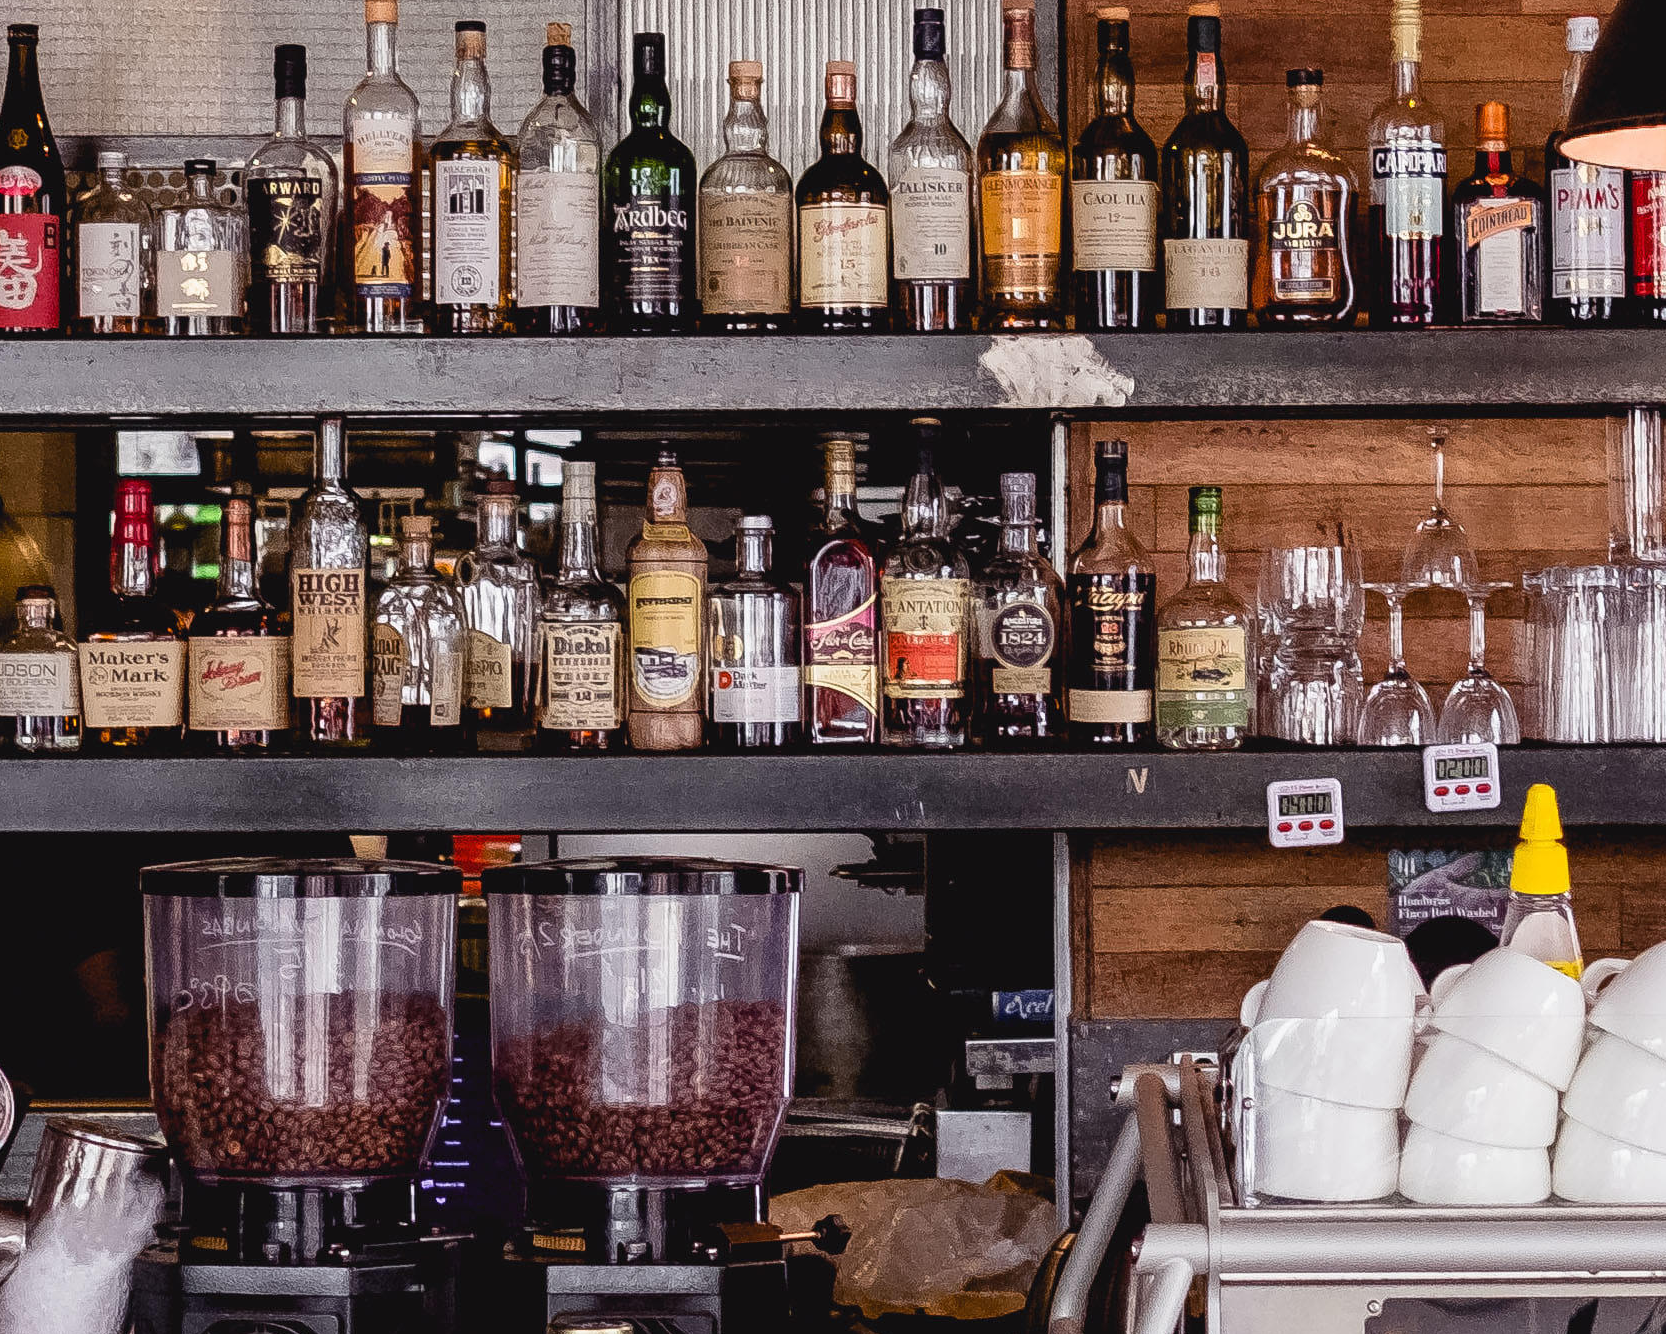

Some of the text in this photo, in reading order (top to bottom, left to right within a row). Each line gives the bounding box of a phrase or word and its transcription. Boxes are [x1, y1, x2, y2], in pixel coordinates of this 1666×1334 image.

[1375, 151, 1447, 174] CAMPARI
[898, 181, 964, 194] TALISKER
[984, 177, 1060, 192] GLENMORANGIE
[1083, 192, 1146, 206] CAOL ILA
[726, 217, 779, 228] BALVENIE
[1470, 203, 1528, 240] COINTREAU
[1272, 222, 1334, 239] JURA
[933, 242, 947, 257] 10
[298, 573, 360, 592] HIGH
[298, 594, 359, 606] WEST
[298, 607, 360, 616] WHISKEY
[999, 631, 1046, 646] 1824
[88, 651, 169, 666] Maker's
[111, 668, 169, 683] Mark
[1397, 894, 1451, 907] Honduras
[1398, 908, 1429, 920] Finca
[1456, 906, 1498, 918] Washed
